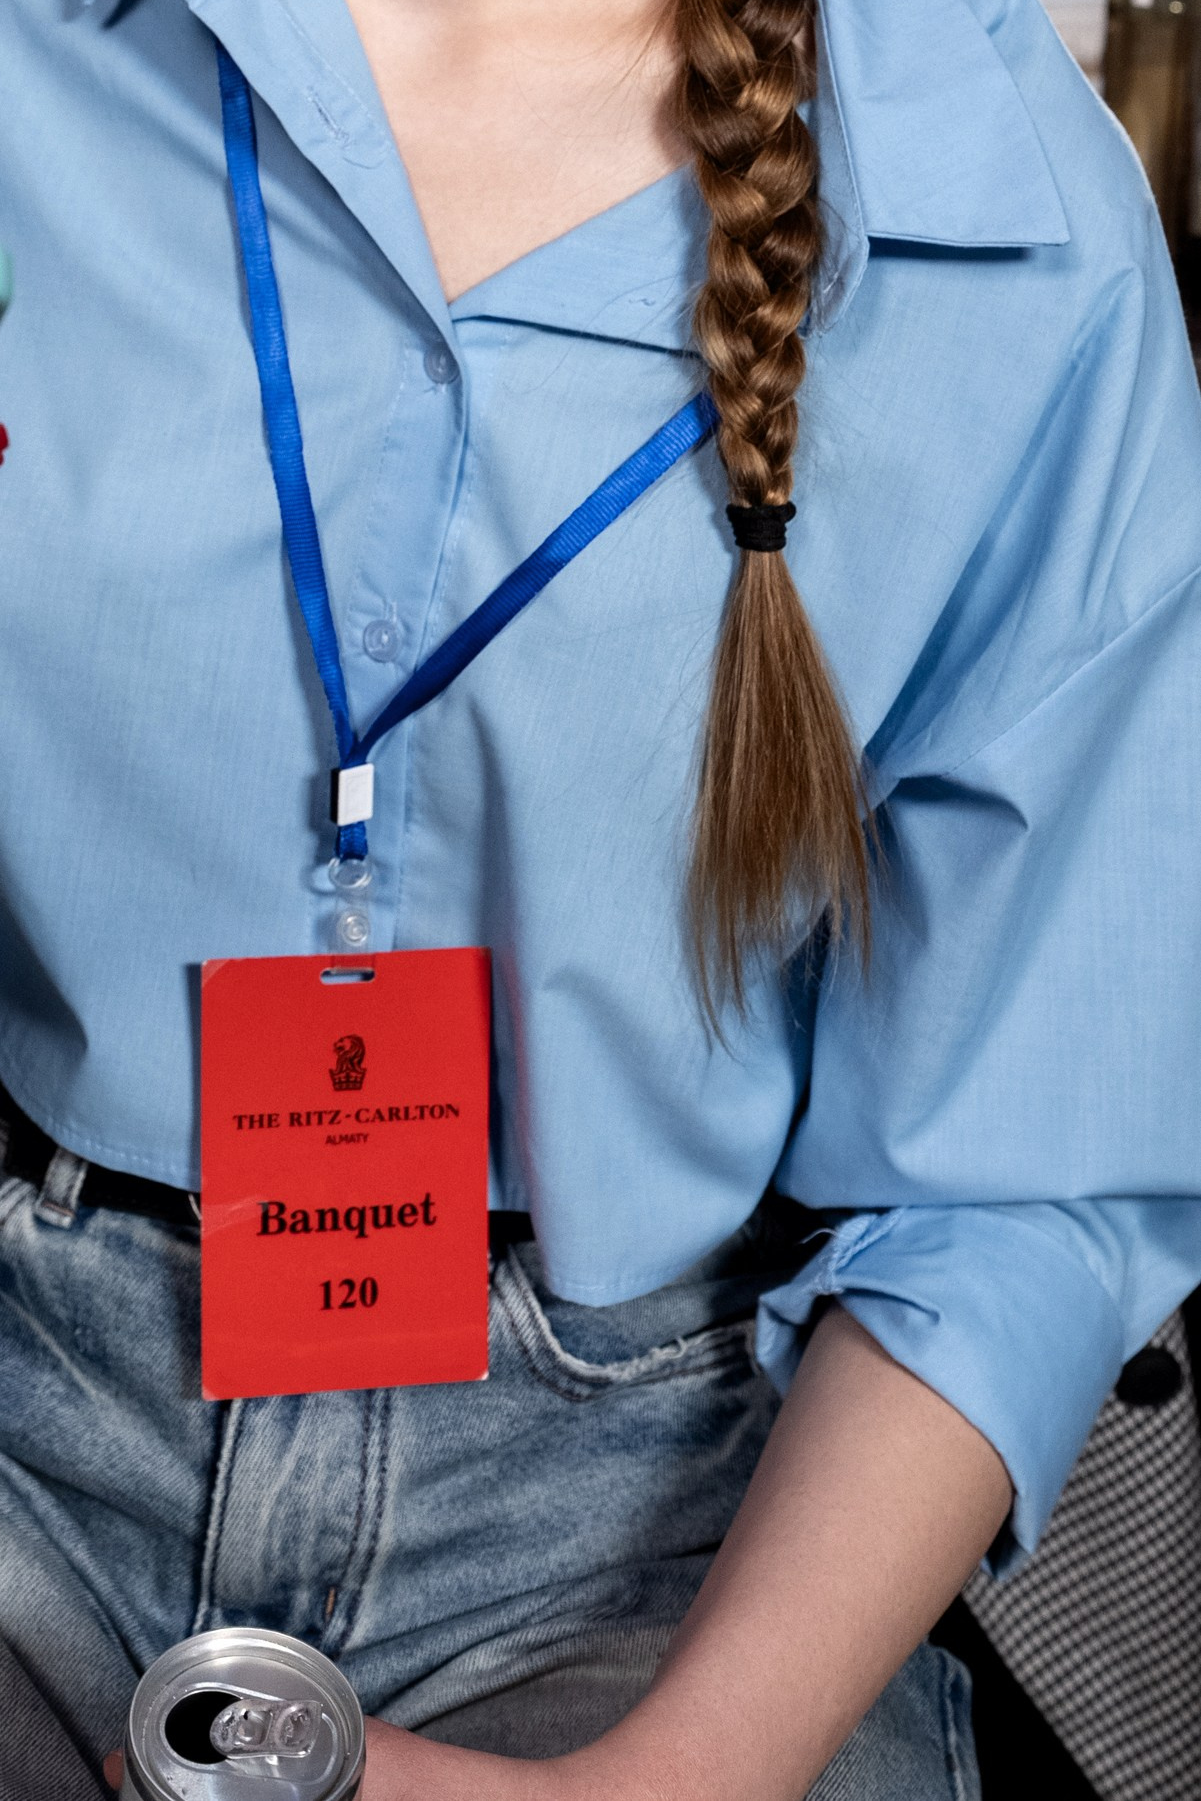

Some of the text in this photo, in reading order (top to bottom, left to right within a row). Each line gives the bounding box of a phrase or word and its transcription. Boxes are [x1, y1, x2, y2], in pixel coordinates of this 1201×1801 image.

[232, 1103, 460, 1131] THE RITZ-CARLTON
[325, 1132, 369, 1146] ALMATY
[256, 1192, 437, 1239] Banquet
[320, 1277, 379, 1311] 120
